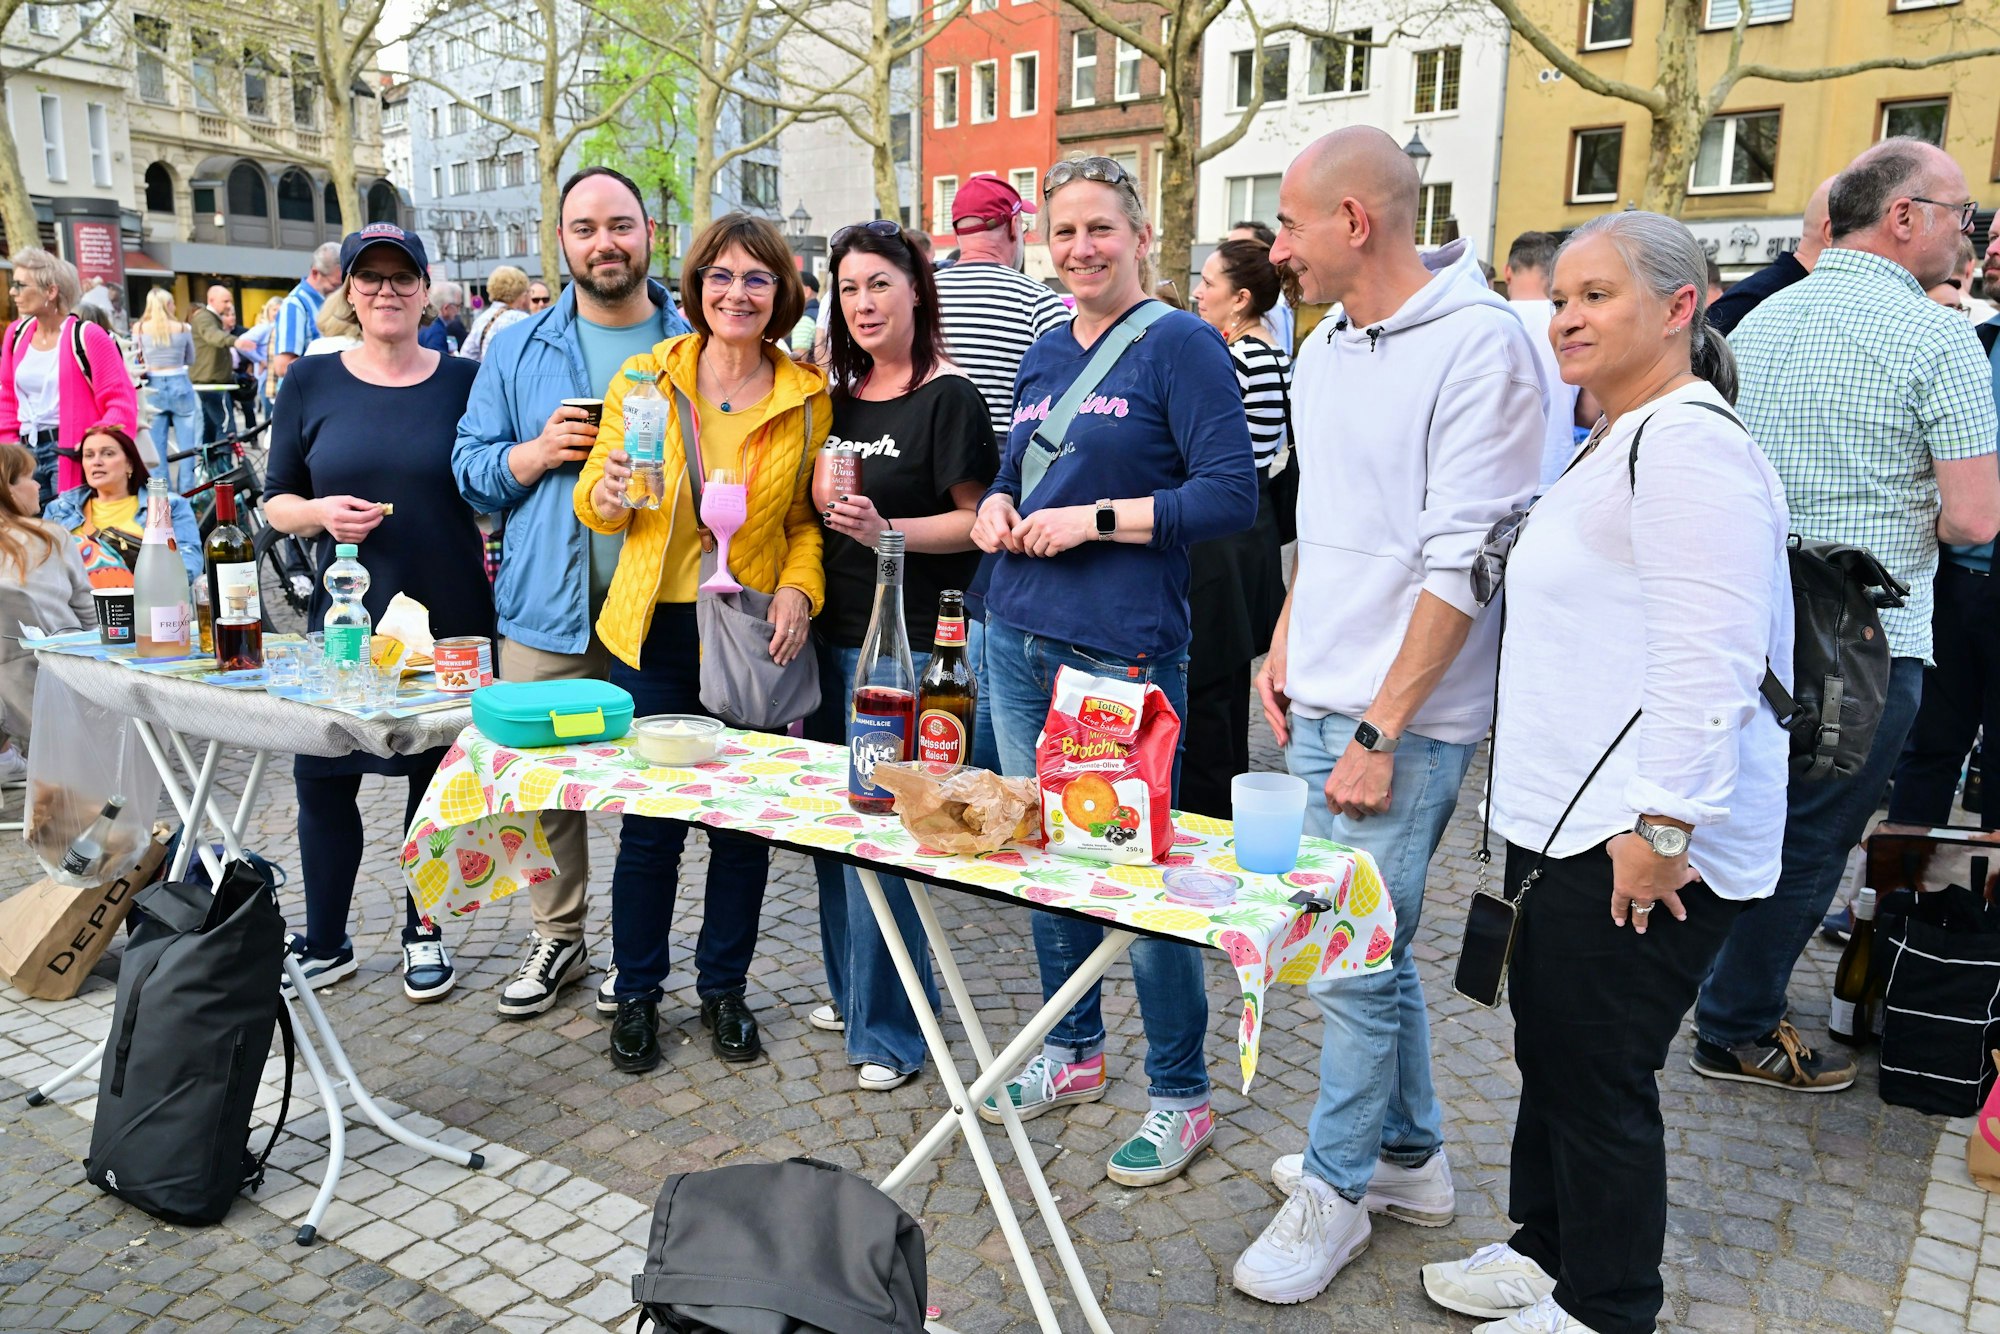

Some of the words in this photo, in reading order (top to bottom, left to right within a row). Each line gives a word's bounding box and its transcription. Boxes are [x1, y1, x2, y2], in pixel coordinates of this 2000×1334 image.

[823, 434, 900, 459] Bench.
[830, 463, 855, 476] Vino
[1097, 701, 1124, 715] Tottis
[920, 735, 959, 750] Reissdorf
[1061, 736, 1129, 759] Brotchips
[48, 864, 141, 976] DEPO
